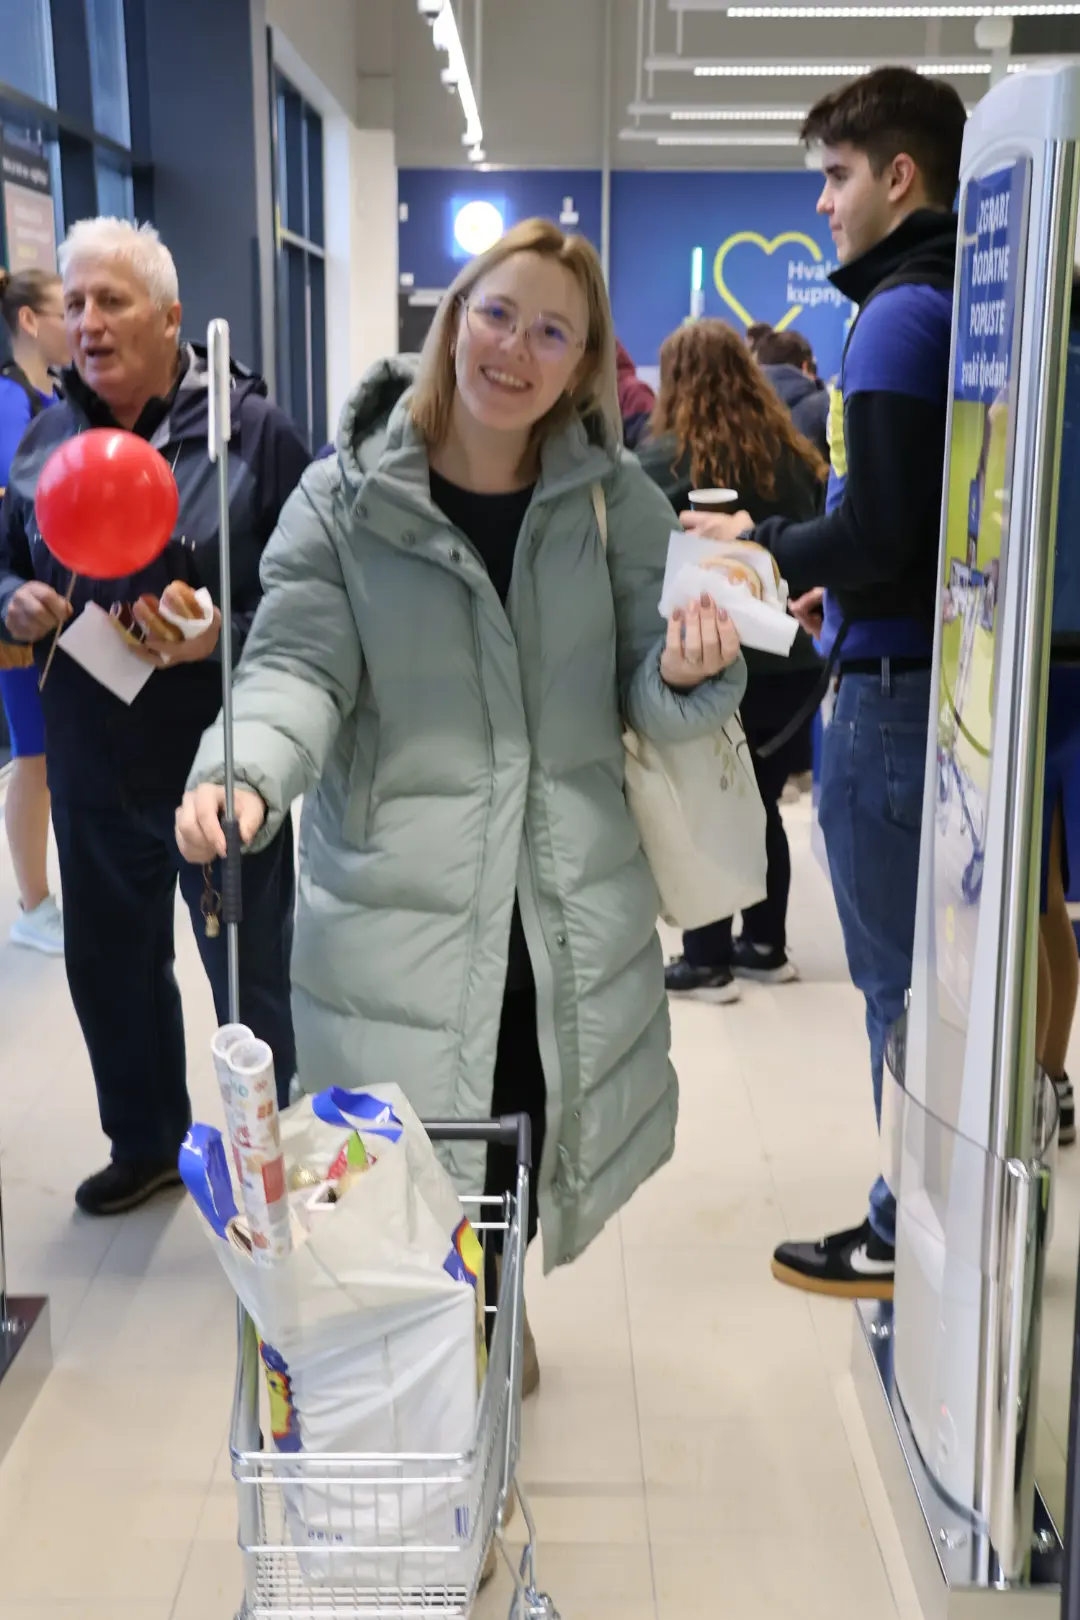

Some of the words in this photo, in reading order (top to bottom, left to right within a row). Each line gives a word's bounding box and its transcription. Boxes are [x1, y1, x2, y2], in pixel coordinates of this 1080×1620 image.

[978, 192, 1010, 234] ZGRABI
[971, 245, 1010, 287] DODATNE
[969, 298, 1006, 337] POPUSTE
[961, 352, 979, 387] svaki
[980, 352, 1009, 394] tjedan!
